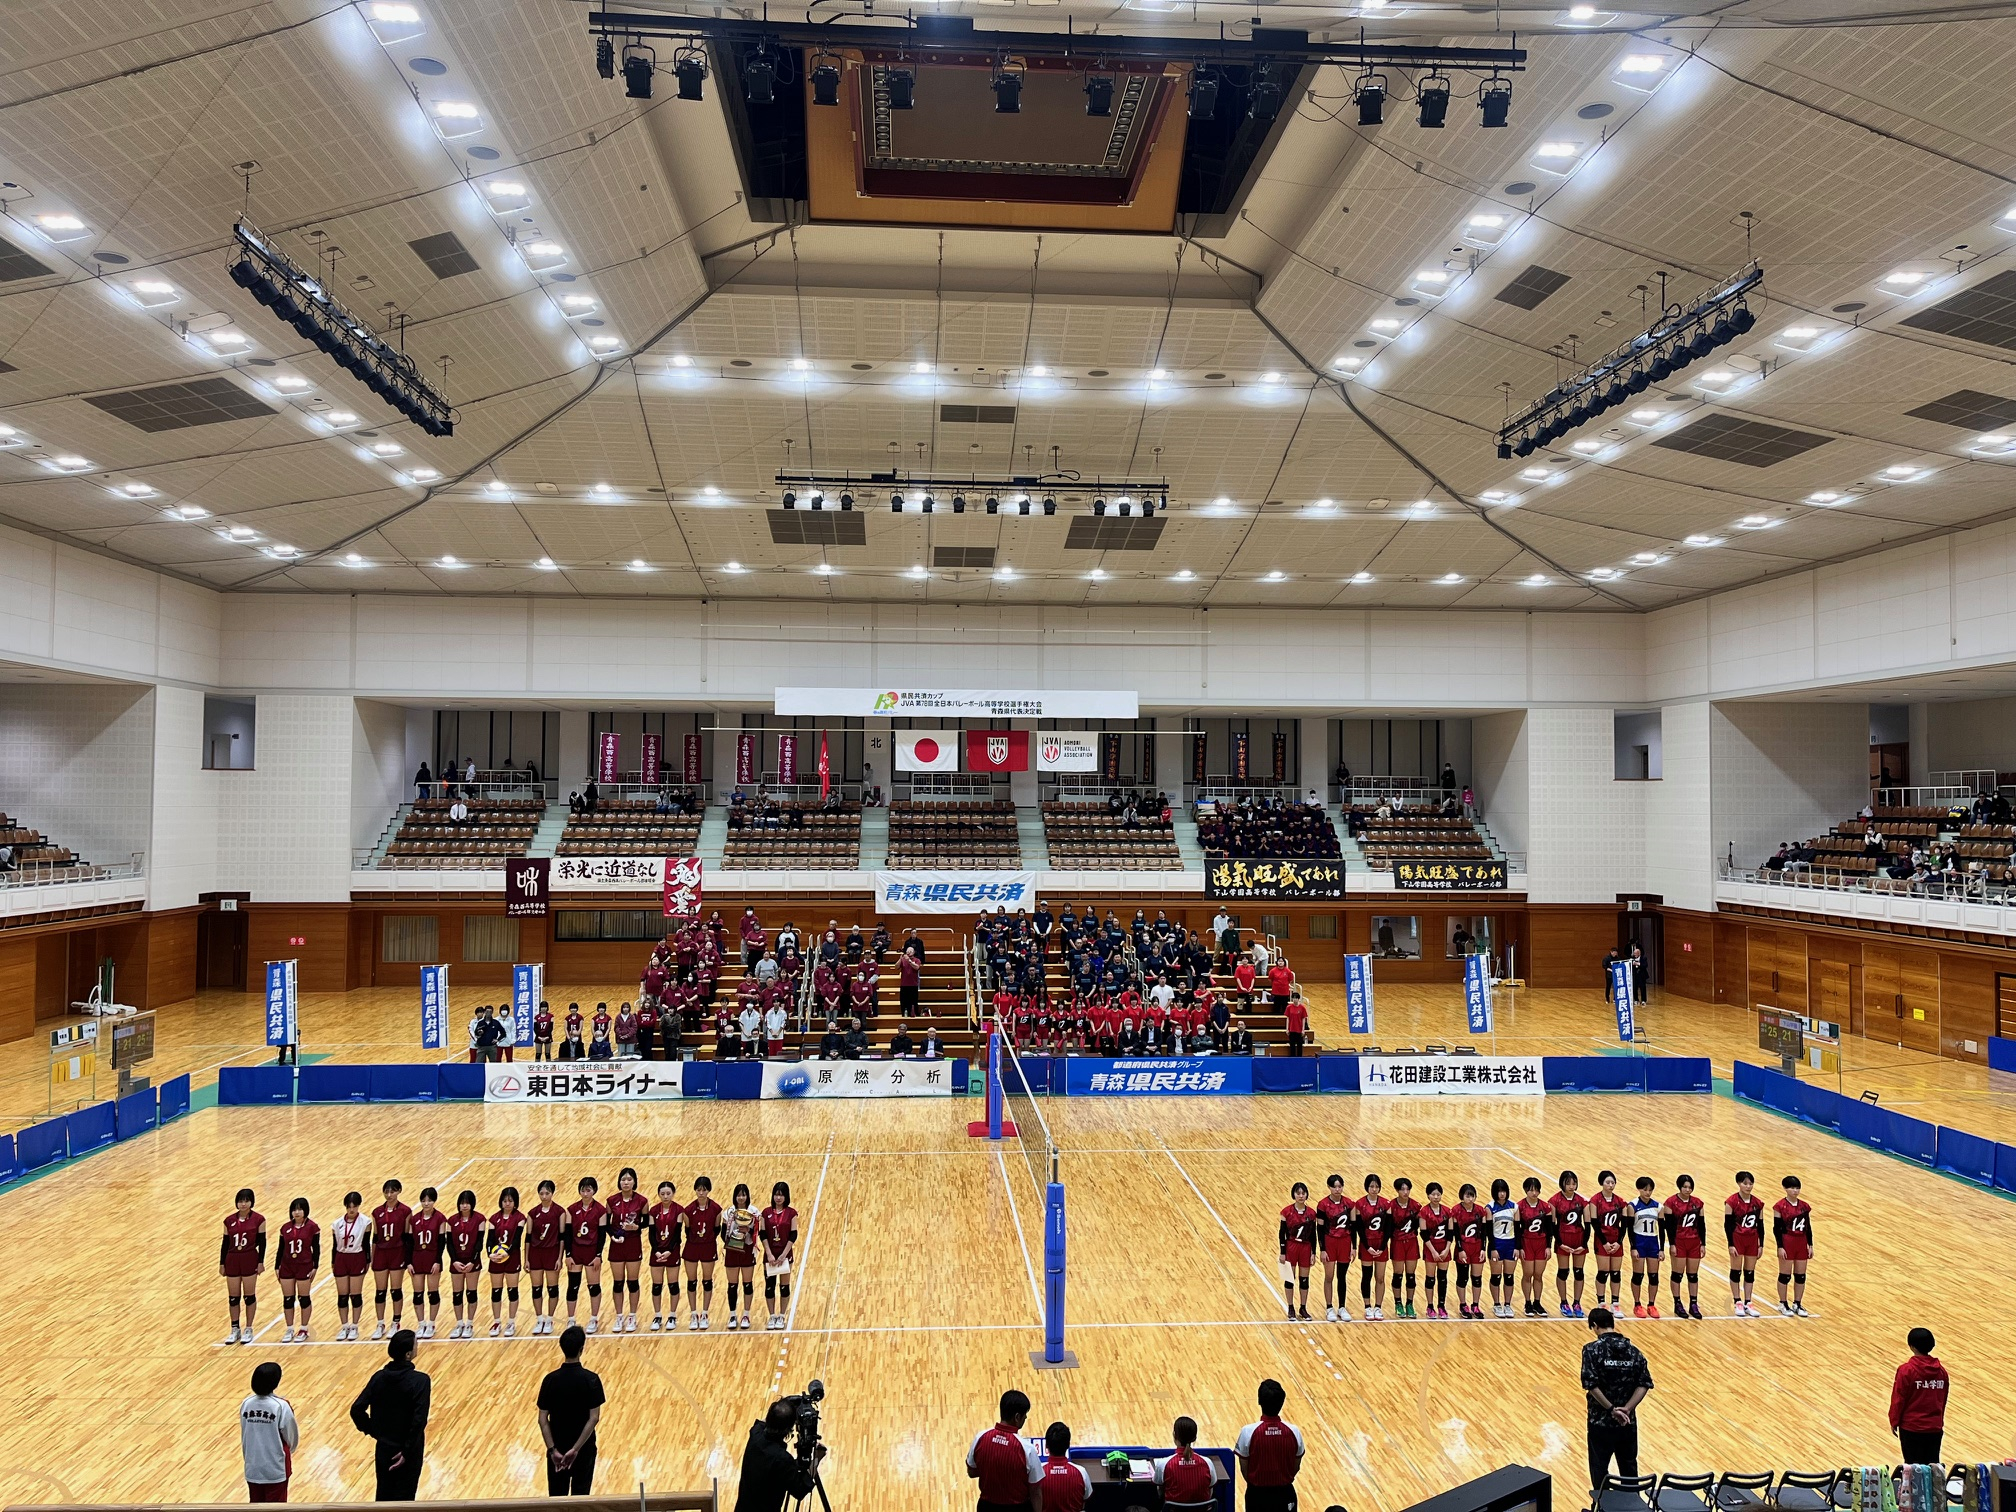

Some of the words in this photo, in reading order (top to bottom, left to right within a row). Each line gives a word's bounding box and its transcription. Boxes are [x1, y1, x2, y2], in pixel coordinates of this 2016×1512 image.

[900, 692, 944, 700] 県民共済カップ
[870, 737, 882, 748] 北
[604, 736, 615, 782] 青森西高等学校
[558, 859, 658, 879] 栄光に近道なし
[886, 883, 1025, 902] 青森県民共済
[1213, 888, 1276, 896] 下山学園高等学校
[1285, 889, 1340, 897] バレーボール部
[1349, 961, 1364, 1028] 青森県民共済
[1469, 961, 1484, 1027] 青森県民共済
[1615, 967, 1631, 1035] 青森県民共済
[269, 968, 284, 1040] 青森県民共済
[425, 972, 437, 1044] 青森県民共済
[517, 971, 530, 1043] 青森県民共済
[540, 1021, 547, 1030] 17
[1768, 1026, 1777, 1038] 25
[137, 1034, 146, 1046] 25
[1782, 1030, 1791, 1041] 21
[123, 1038, 132, 1050] 21
[1112, 1061, 1204, 1069] 都道府県民共済グループ
[1090, 1072, 1226, 1091] 青森県民共済
[1389, 1065, 1537, 1084] 花田建設工業株式会社
[527, 1073, 677, 1097] 東日本ライナー
[1336, 1215, 1347, 1229] 2
[1369, 1217, 1381, 1230] 3
[1566, 1212, 1578, 1224] 9
[1604, 1212, 1617, 1226] 10
[1682, 1214, 1696, 1227] 12
[1741, 1214, 1755, 1227] 13
[1792, 1218, 1805, 1231] 14
[382, 1223, 395, 1238] 11
[542, 1223, 550, 1238] 7
[580, 1222, 589, 1235] 6
[662, 1225, 668, 1238] 4
[1401, 1219, 1411, 1233] 4
[1434, 1225, 1446, 1239] 5
[1465, 1223, 1477, 1237] 6
[1501, 1221, 1509, 1234] 7
[1529, 1219, 1542, 1232] 8
[1642, 1220, 1654, 1232] 11
[417, 1231, 432, 1245] 10
[459, 1232, 468, 1246] 9
[772, 1226, 780, 1240] 1
[1295, 1225, 1305, 1242] 1
[289, 1239, 302, 1254] 13
[1915, 1380, 1944, 1389] 下山学園
[992, 1437, 1009, 1446] REFEREE
